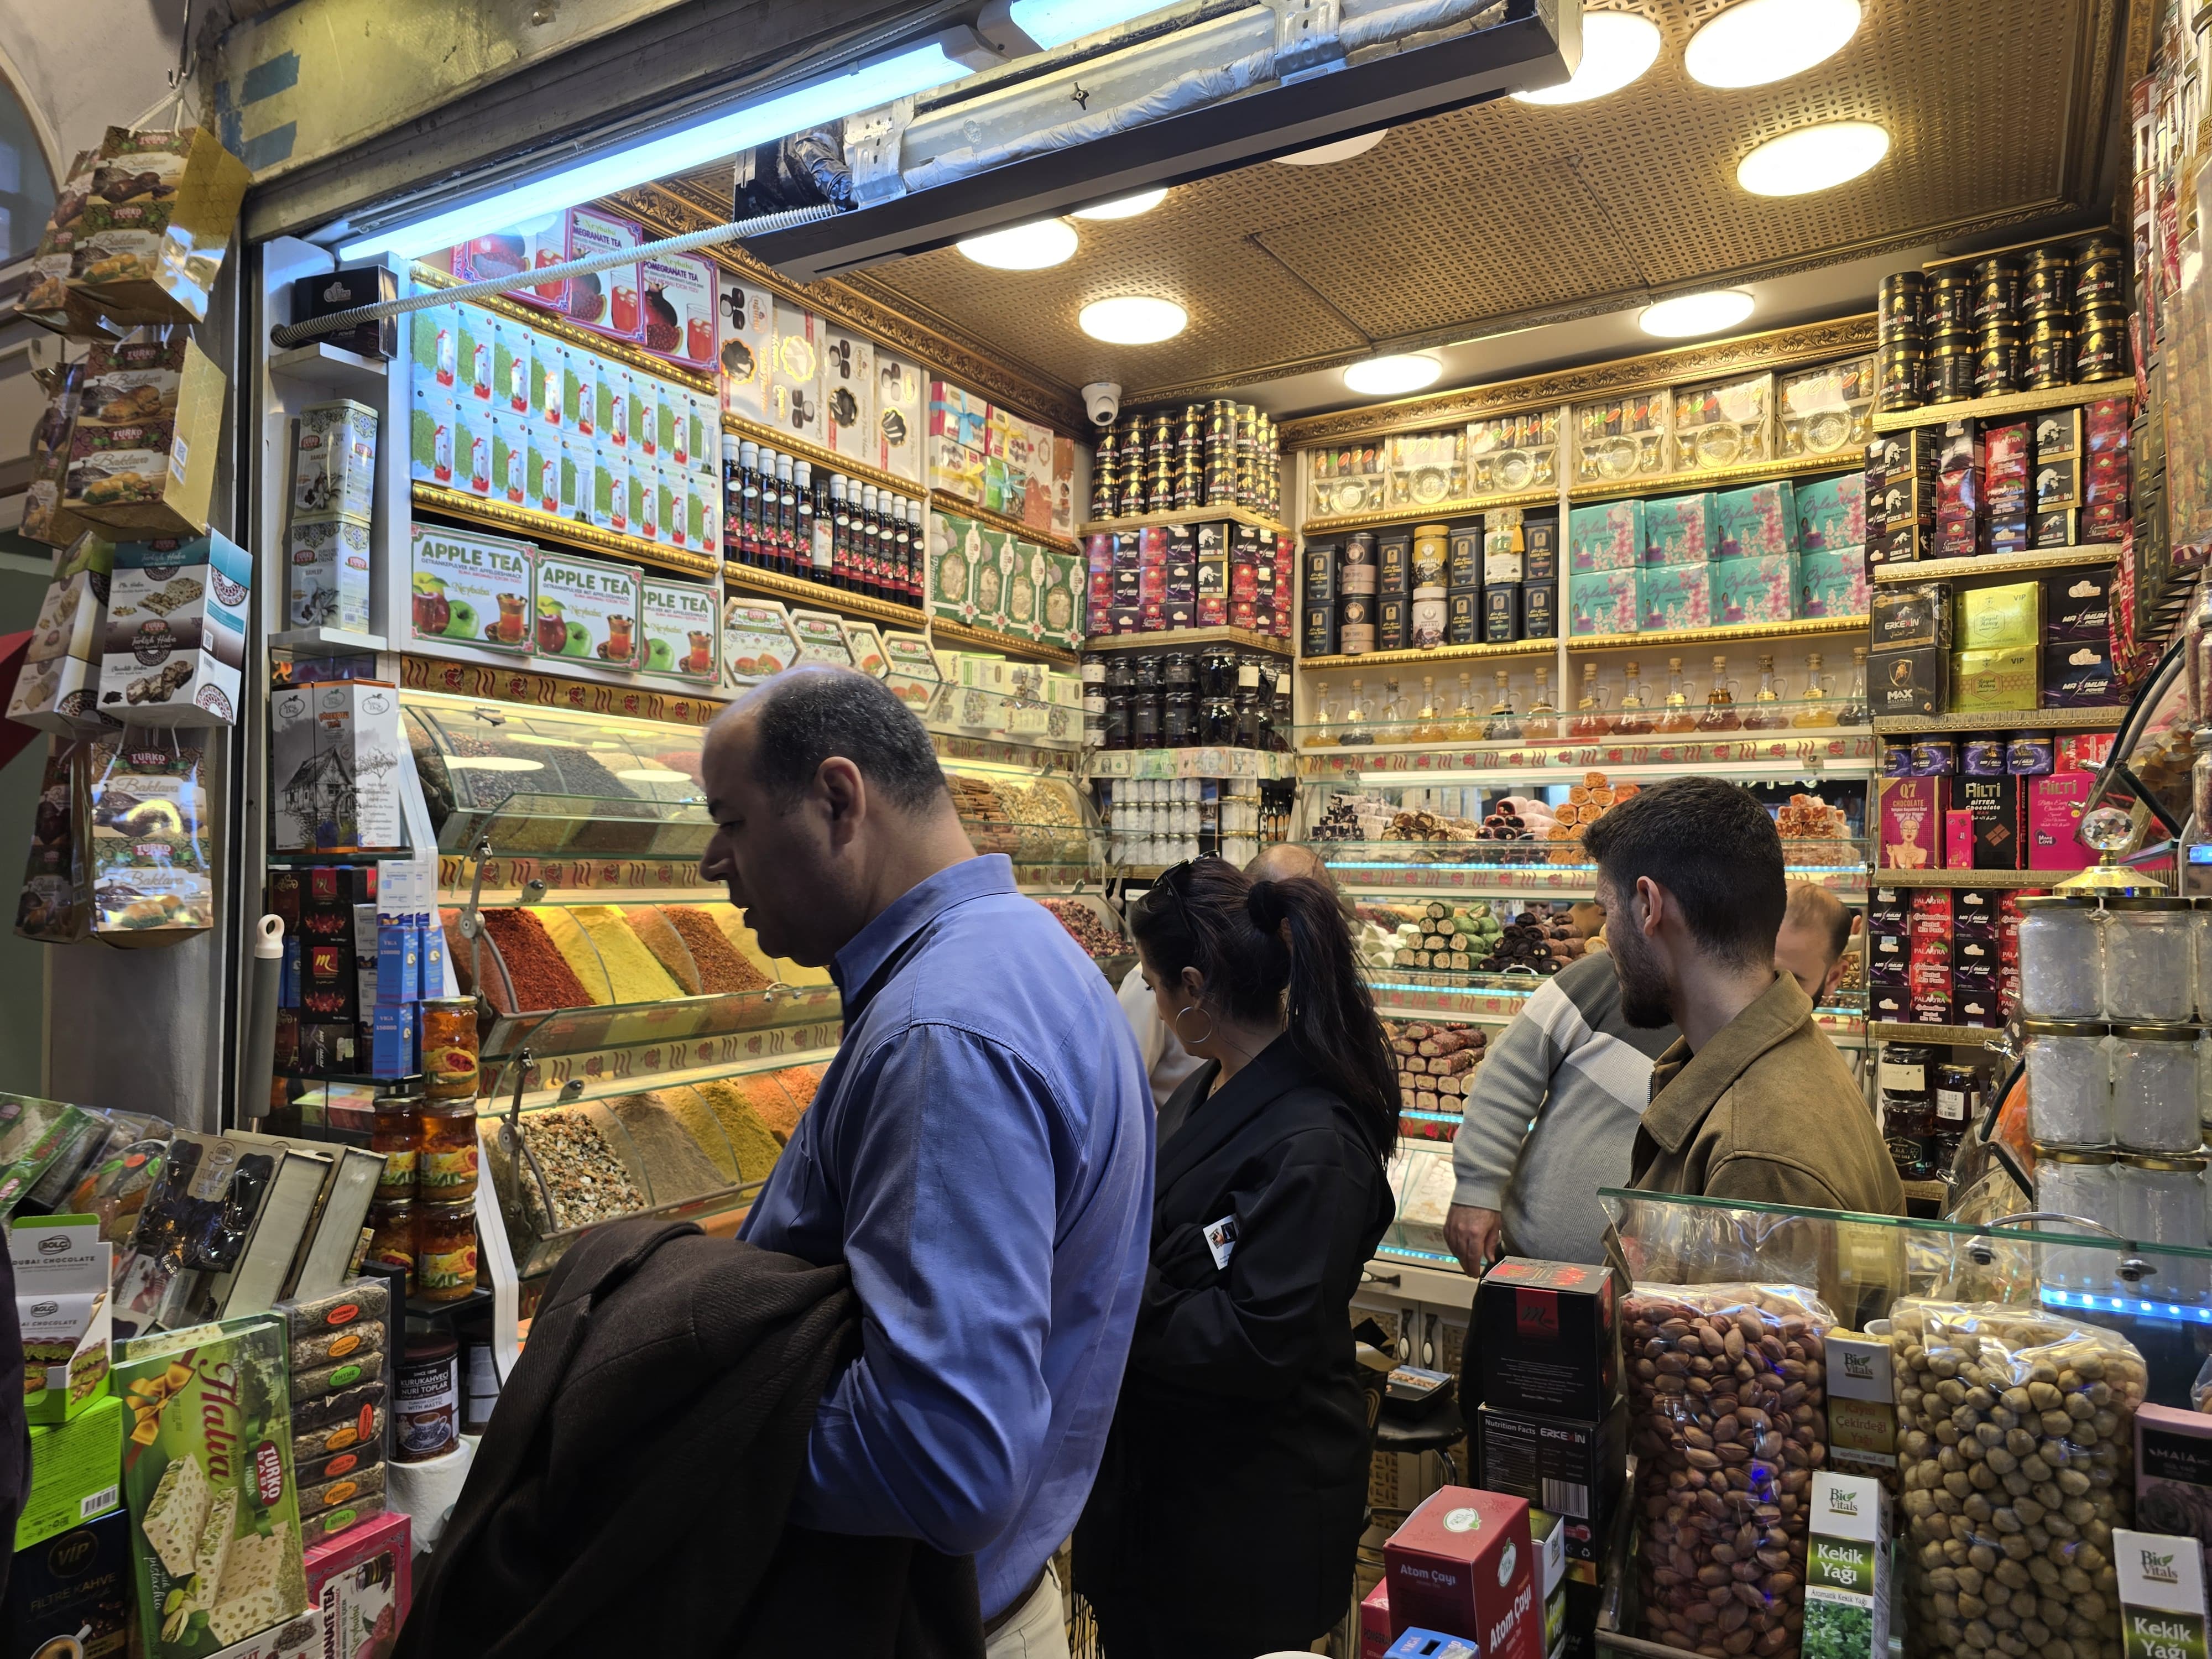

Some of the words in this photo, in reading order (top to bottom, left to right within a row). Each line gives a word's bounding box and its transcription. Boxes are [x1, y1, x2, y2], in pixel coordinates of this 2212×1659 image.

[573, 226, 611, 245] MEGRANATE
[611, 238, 622, 248] TEA
[643, 261, 687, 279] POMEGRANATE
[688, 273, 699, 283] TEA
[421, 540, 483, 566] APPLE
[488, 552, 523, 573] TEA
[451, 582, 491, 598] Neybaba
[543, 567, 596, 590] APPLE
[601, 576, 630, 596] TEA
[680, 596, 708, 613] TEA
[2013, 593, 2027, 602] VIP
[1887, 688, 1913, 701] MAX
[132, 753, 165, 761] TURKO
[116, 778, 179, 794] Baklava
[1900, 783, 1917, 799] Q7
[121, 870, 184, 886] Baklava
[43, 1256, 96, 1264] CHOCOLATE
[331, 1338, 358, 1354] ORANGE
[1844, 1352, 1866, 1367] Bio
[335, 1369, 356, 1381] THYME
[400, 1369, 449, 1386] KURUKAHVECİ
[1845, 1363, 1873, 1376] Vitals
[401, 1387, 419, 1395] NURİ
[421, 1381, 447, 1394] TOPLAR
[424, 1400, 443, 1408] MASTIC
[1844, 1401, 1876, 1417] Kayısı
[199, 1358, 243, 1488] Halva
[1485, 1418, 1517, 1432] Nutrition
[1517, 1426, 1536, 1435] Facts
[1835, 1415, 1887, 1434] Çekirdeği
[1850, 1430, 1873, 1447] Yağı
[245, 1465, 256, 1497] HALVA
[256, 1451, 269, 1500] BABA
[264, 1445, 281, 1500] TURKO
[1829, 1487, 1856, 1502] Bio
[1830, 1498, 1858, 1512] Vitals
[1817, 1543, 1863, 1565] Kekik
[2141, 1549, 2173, 1567] Bio
[1400, 1564, 1430, 1580] Atom
[1431, 1569, 1456, 1586] Çayı
[1820, 1561, 1858, 1585] Yağı
[2143, 1562, 2178, 1579] Vitals
[74, 1573, 116, 1594] KAHVE
[143, 1556, 166, 1611] pistachio
[324, 1585, 335, 1607] TEA
[1811, 1588, 1837, 1600] Aromatik
[1837, 1593, 1854, 1603] Kekik
[1854, 1595, 1867, 1606] Yağı
[1489, 1611, 1515, 1655] Atom
[1513, 1583, 1532, 1620] Çayı
[324, 1612, 335, 1659] RANATE
[2133, 1616, 2193, 1644] Kekik
[2140, 1637, 2188, 1659] Yağı
